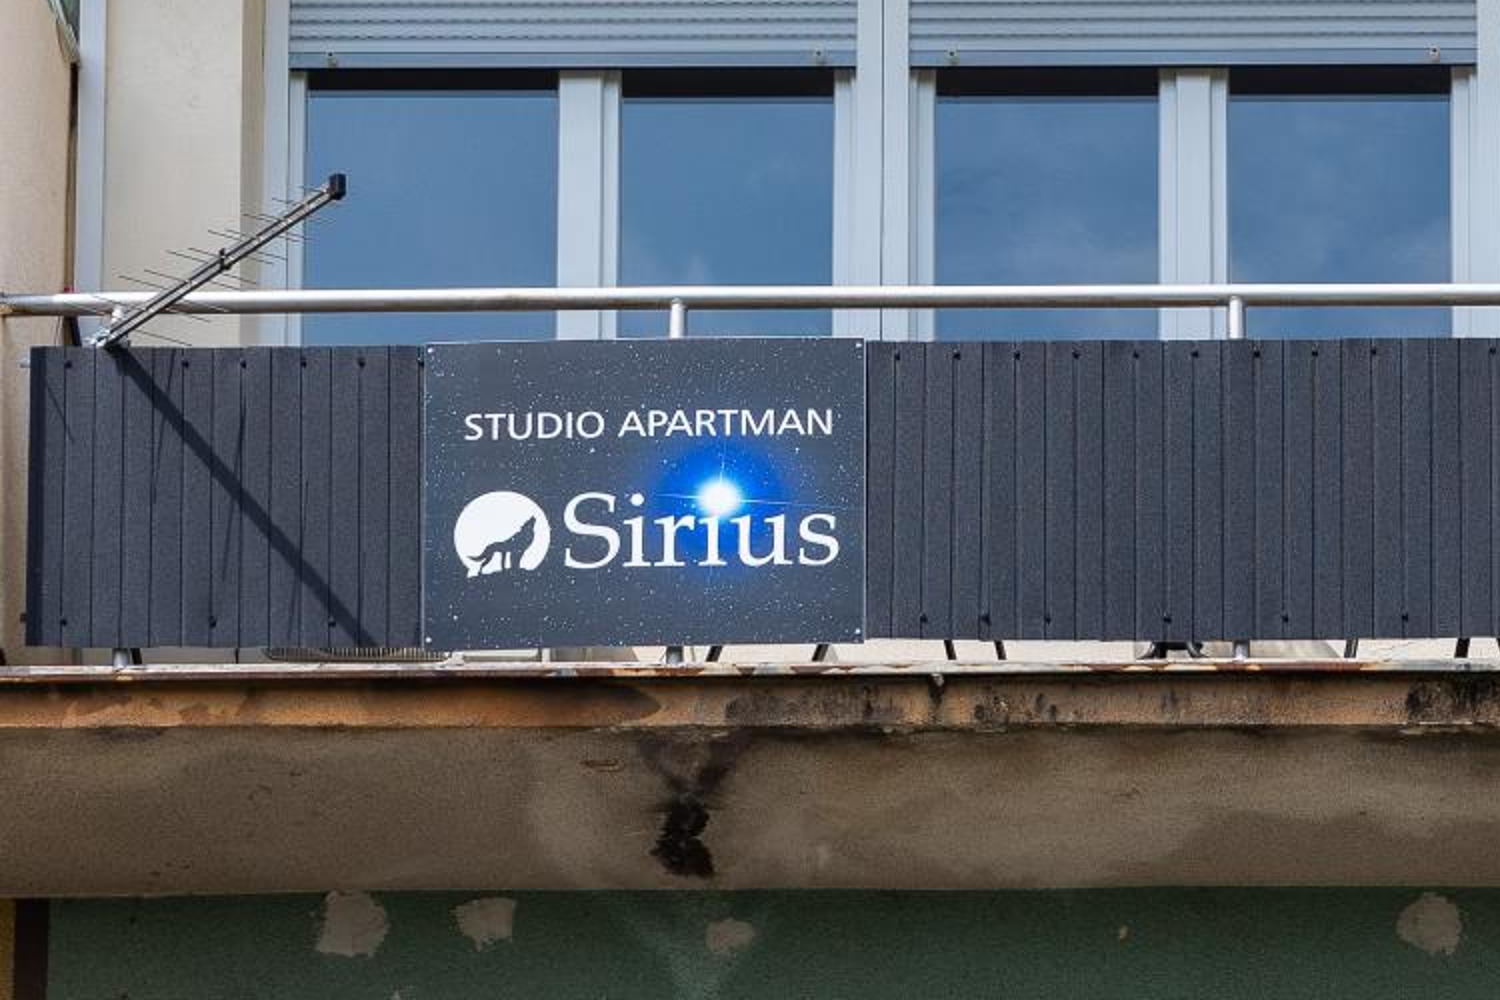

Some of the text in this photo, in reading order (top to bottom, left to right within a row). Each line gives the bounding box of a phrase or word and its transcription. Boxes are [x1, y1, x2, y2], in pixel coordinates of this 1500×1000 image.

[464, 408, 834, 441] STUDIO APARTMAN
[563, 490, 841, 569] Sirius
